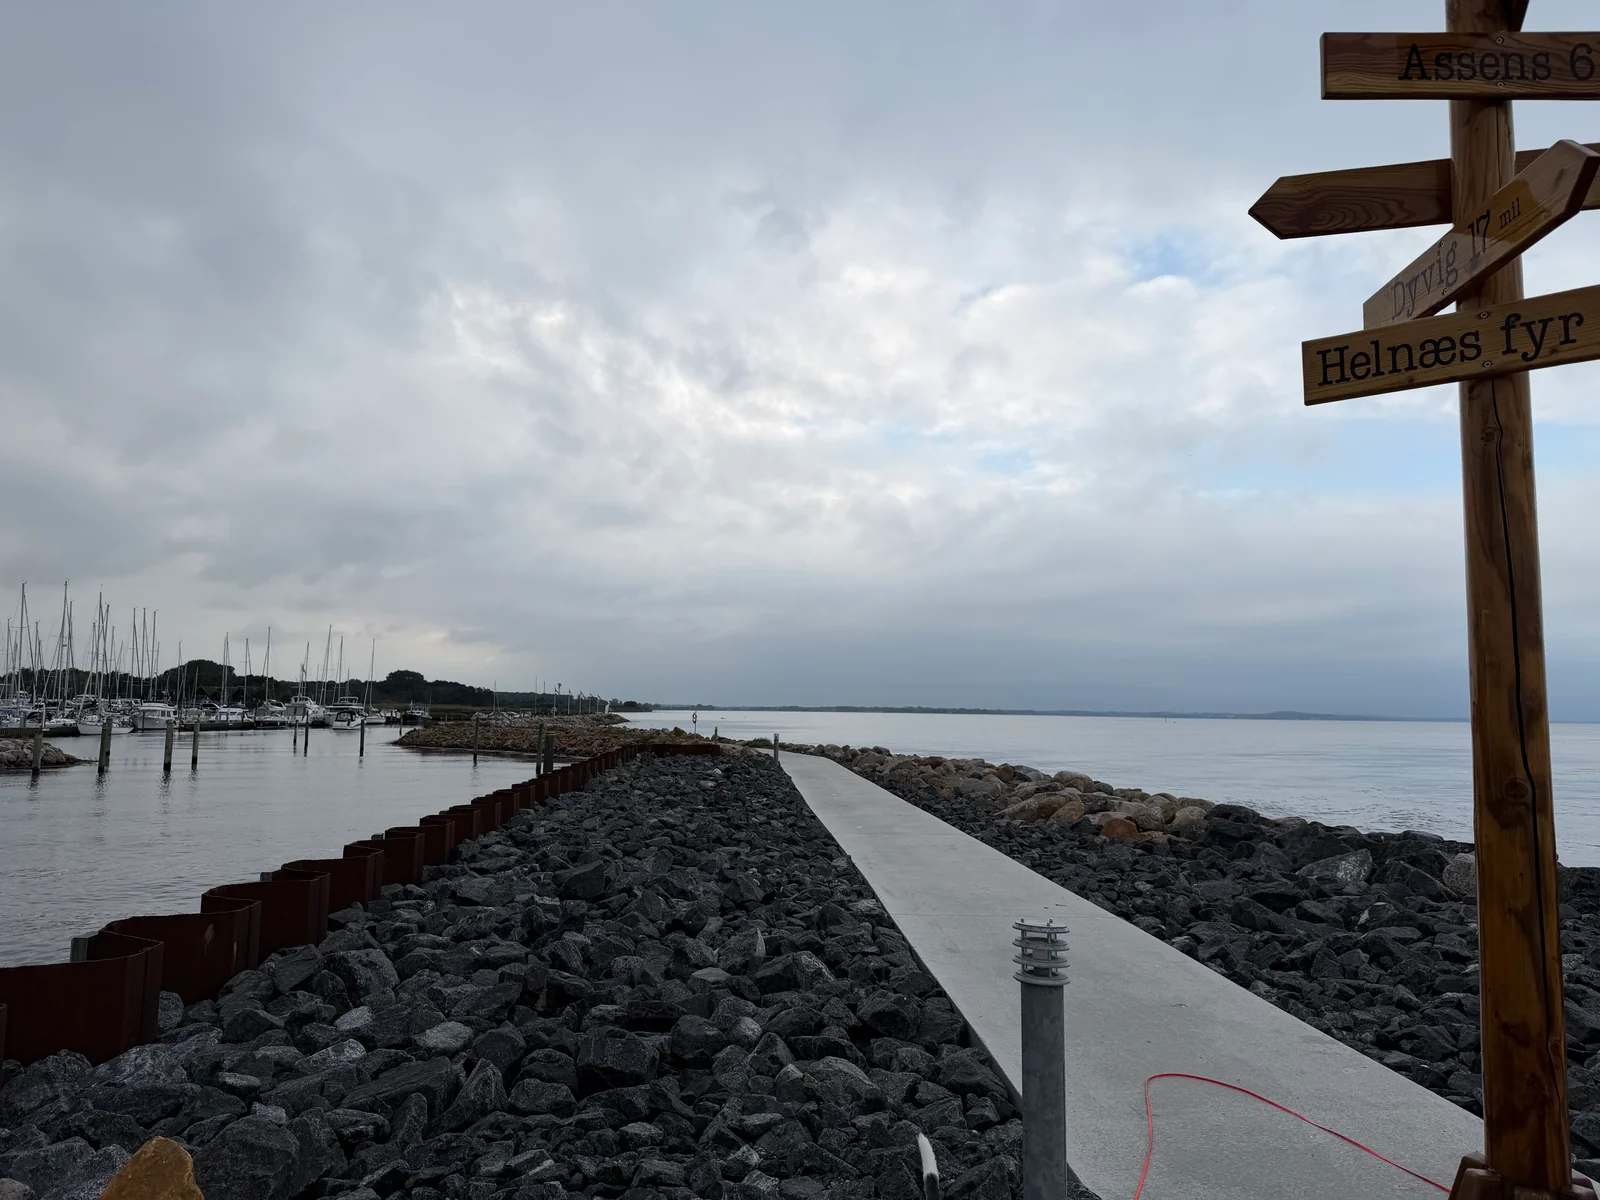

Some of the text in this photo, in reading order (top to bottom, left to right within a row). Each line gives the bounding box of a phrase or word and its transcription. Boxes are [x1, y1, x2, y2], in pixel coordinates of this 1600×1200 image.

[1398, 43, 1596, 81] Assens 6
[1391, 197, 1522, 320] Dyvig 17 mil
[1316, 312, 1584, 386] Helnæs fyr
